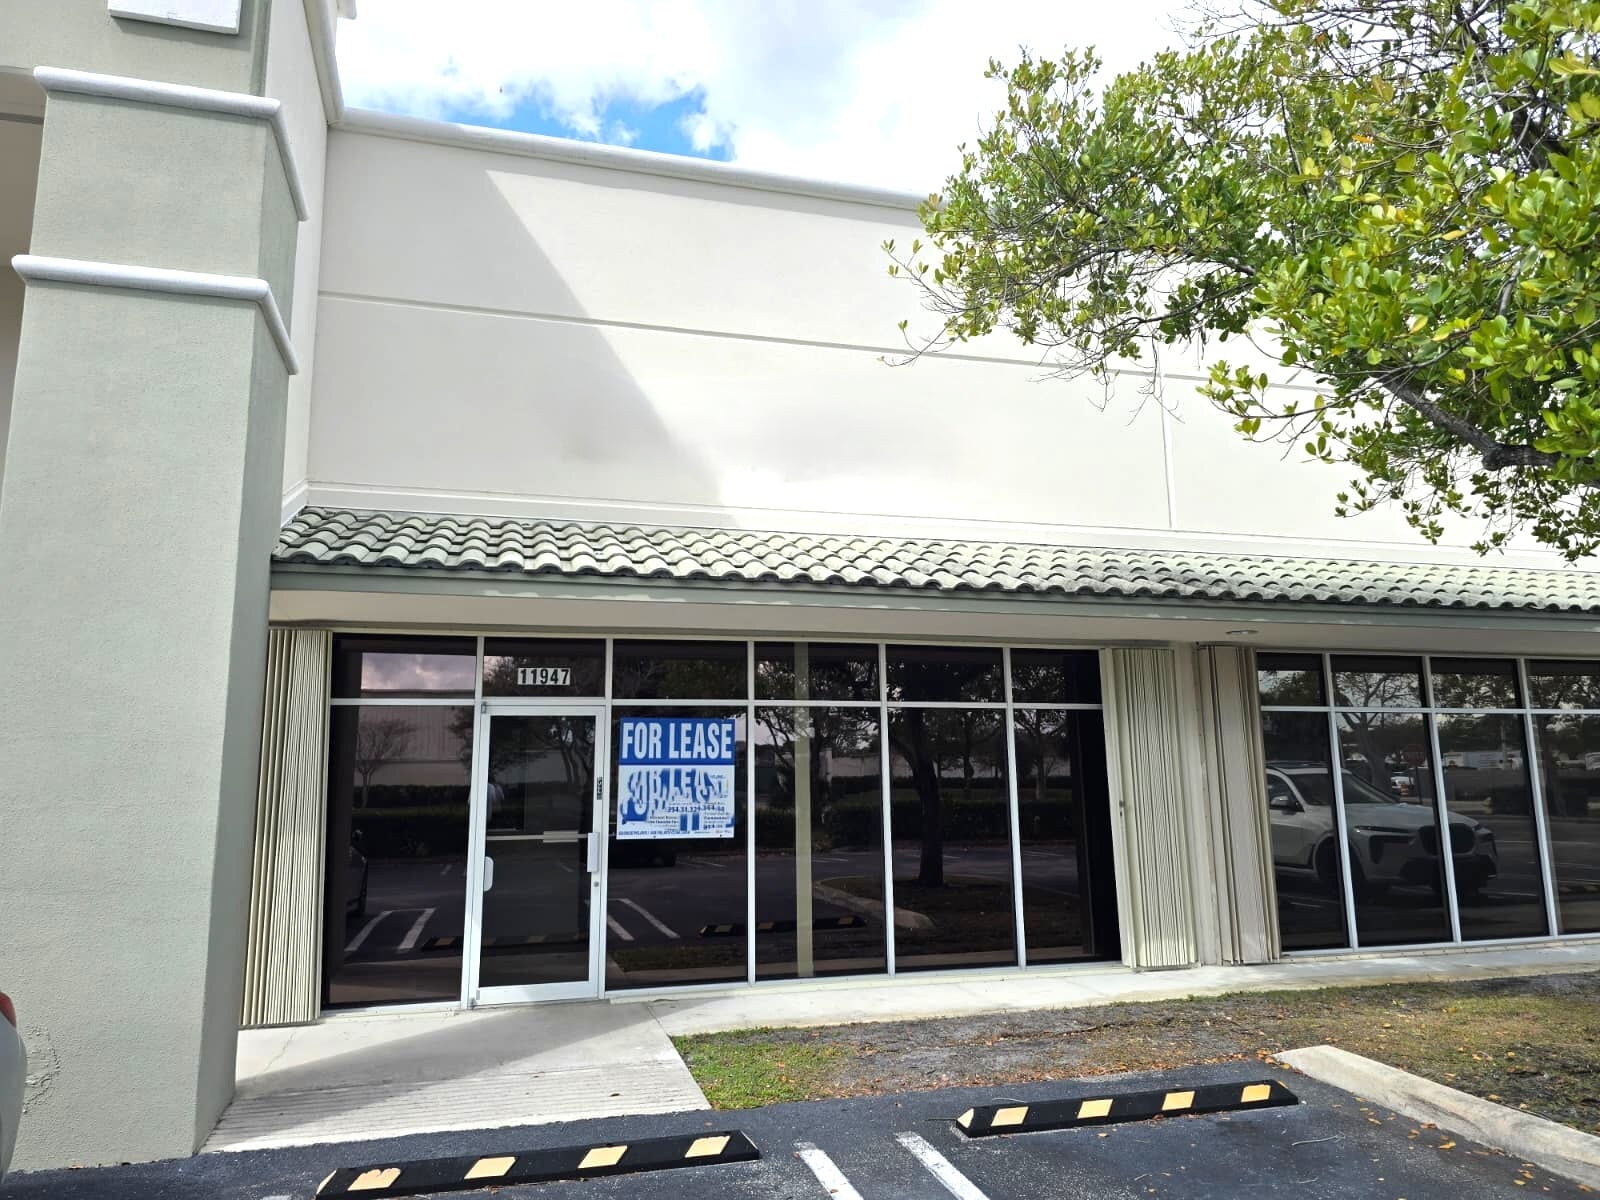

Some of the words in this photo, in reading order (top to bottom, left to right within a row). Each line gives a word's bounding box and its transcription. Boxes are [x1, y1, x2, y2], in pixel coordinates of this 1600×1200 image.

[520, 668, 569, 684] 11947
[622, 722, 662, 759] FOR
[669, 722, 733, 759] LEASE
